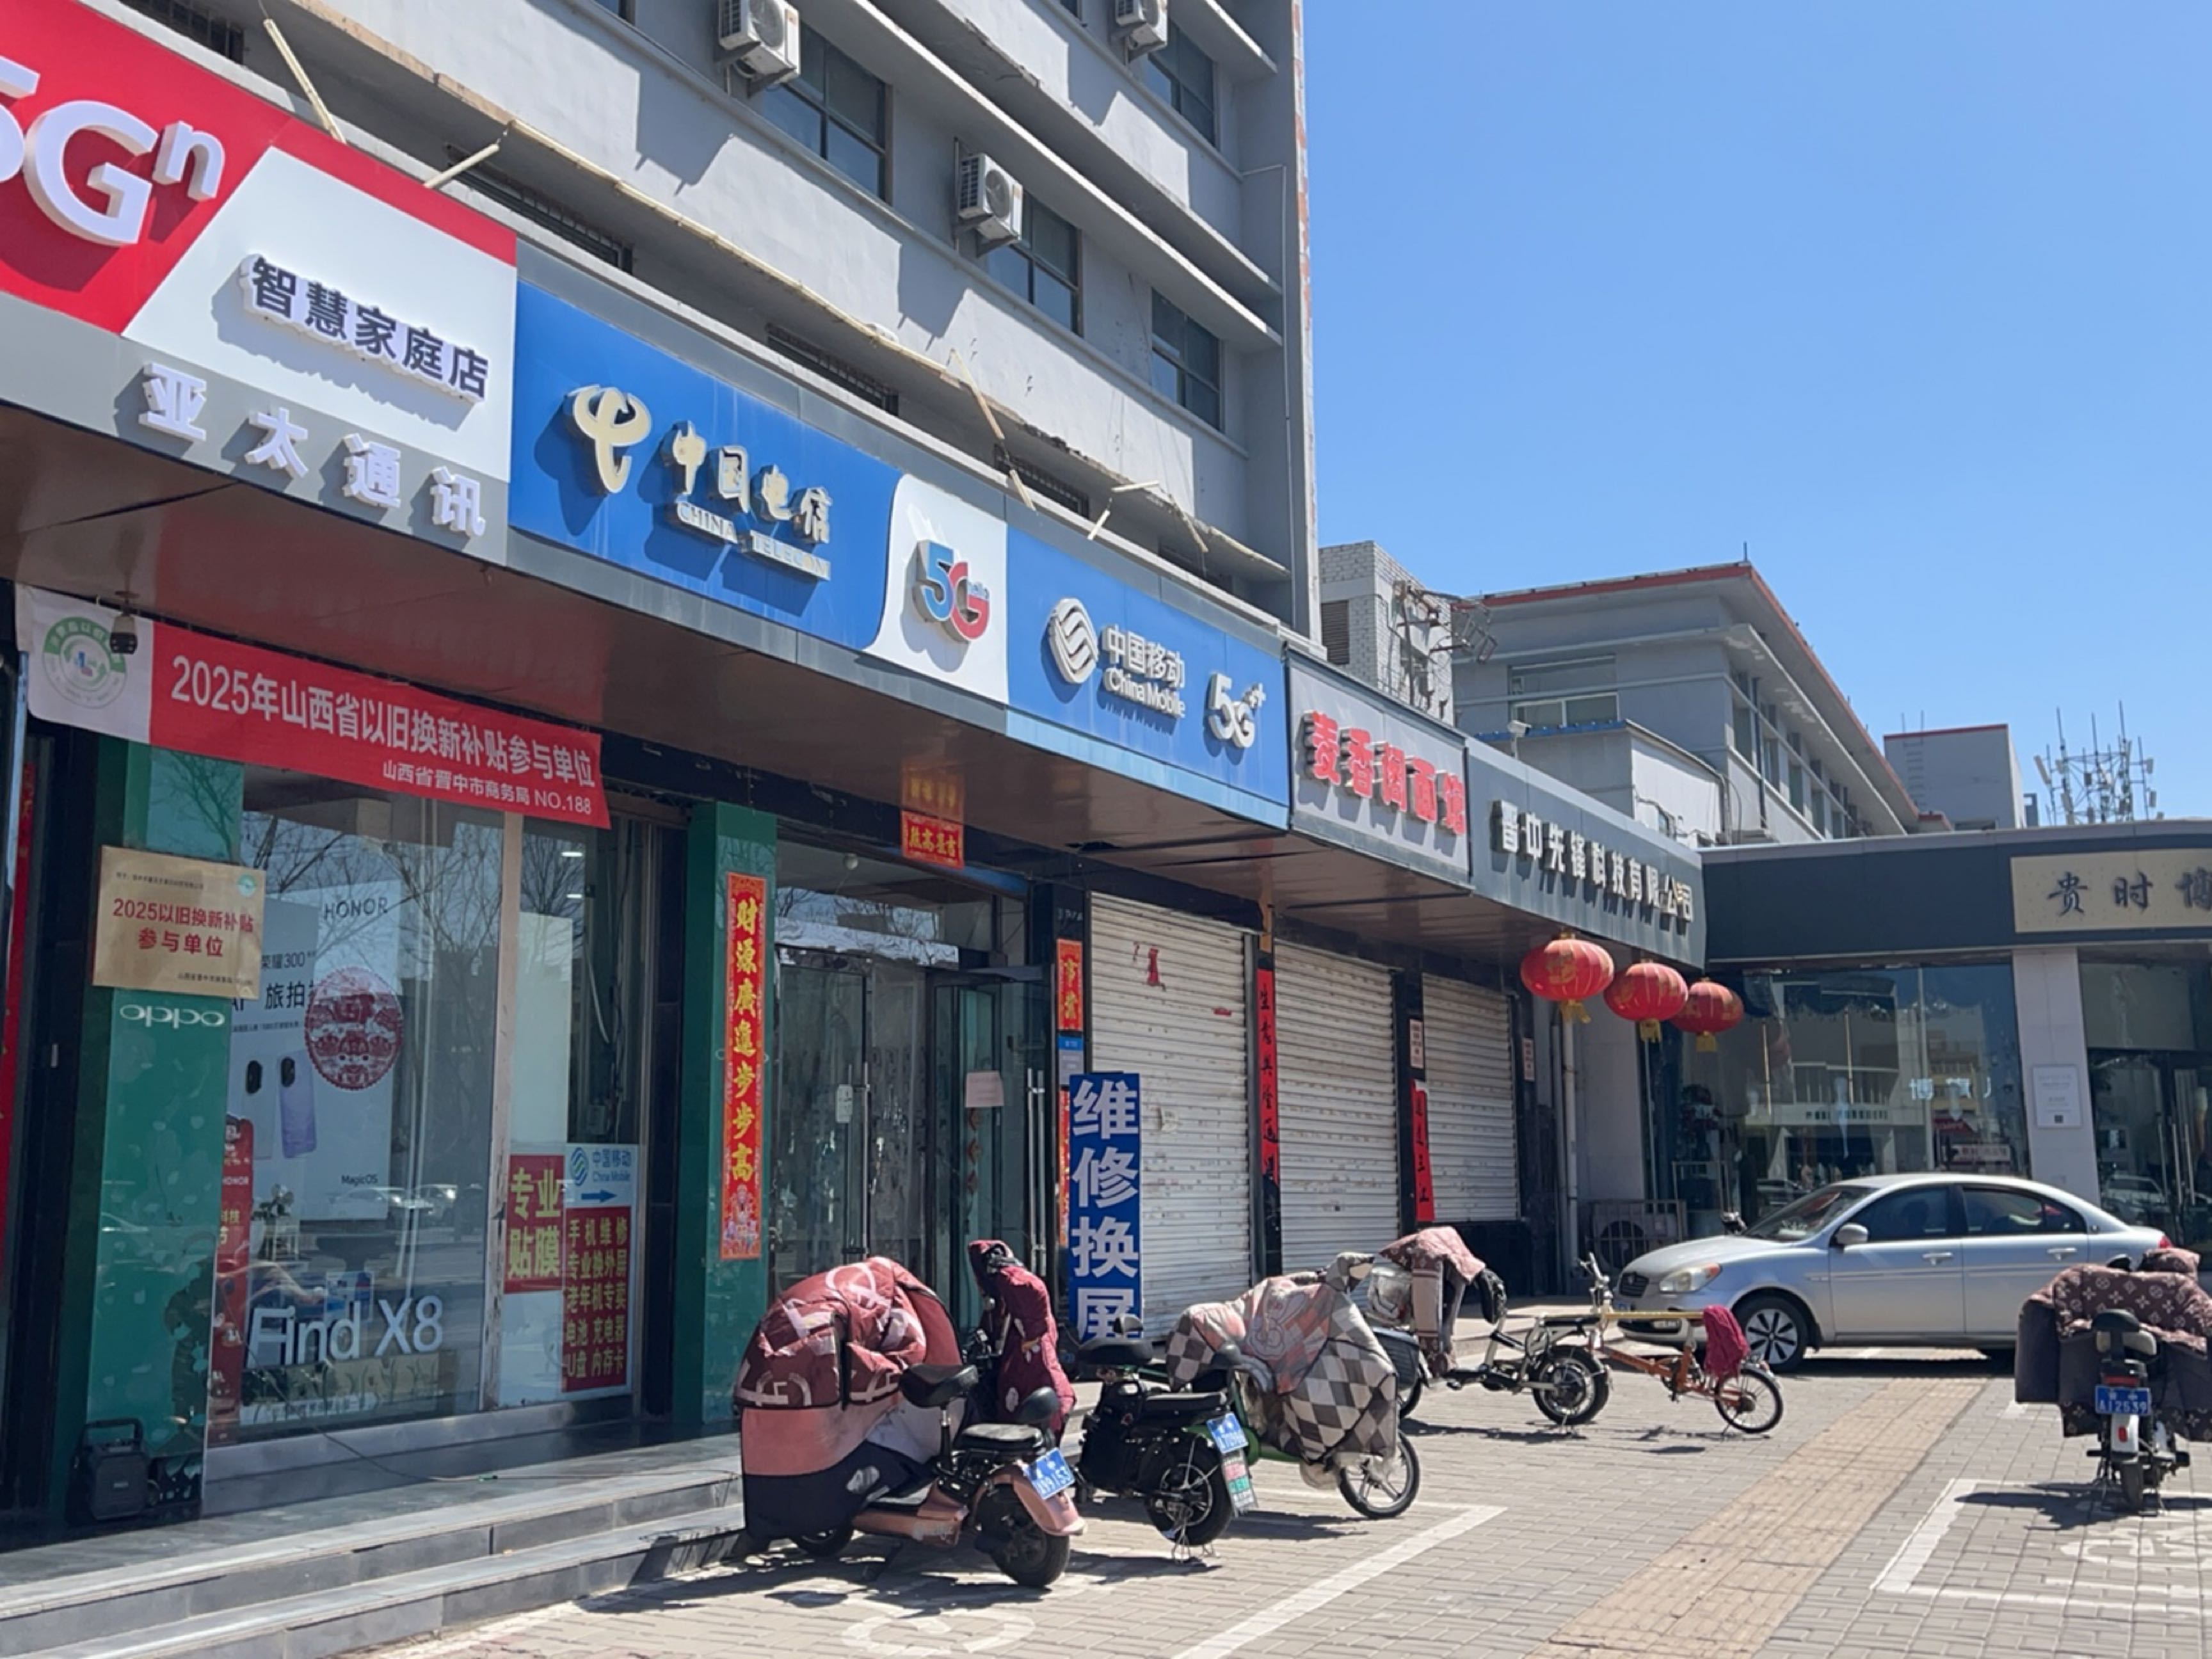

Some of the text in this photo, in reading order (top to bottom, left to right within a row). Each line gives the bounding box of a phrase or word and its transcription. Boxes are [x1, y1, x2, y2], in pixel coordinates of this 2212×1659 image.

[250, 257, 490, 402] 智慧家庭店
[140, 362, 486, 538] 亚太通讯
[671, 421, 833, 544] 中国电信
[677, 501, 738, 544] CHINA
[917, 540, 990, 641] 5G
[1103, 625, 1185, 688] 中国移动
[1104, 666, 1185, 719] China Mobile
[172, 655, 596, 789] 2025年山西省以旧换新补贴参与单位
[383, 759, 591, 815] 山西省晋中市商务局 NO.188
[113, 897, 254, 933] 2025以旧换新补贴
[323, 896, 389, 920] HONOR
[138, 927, 223, 958] 参与单位
[264, 980, 314, 1010] 旅拍
[341, 1173, 379, 1185] MagicOS
[592, 1147, 632, 1169] 中国移动
[509, 1167, 561, 1220] 专业
[1072, 1078, 1139, 1341] 维修换屏
[508, 1225, 561, 1279] 贴膜
[568, 1216, 628, 1248] 手机维修
[566, 1281, 627, 1313] 老年机专卖
[247, 1295, 443, 1368] Find X8
